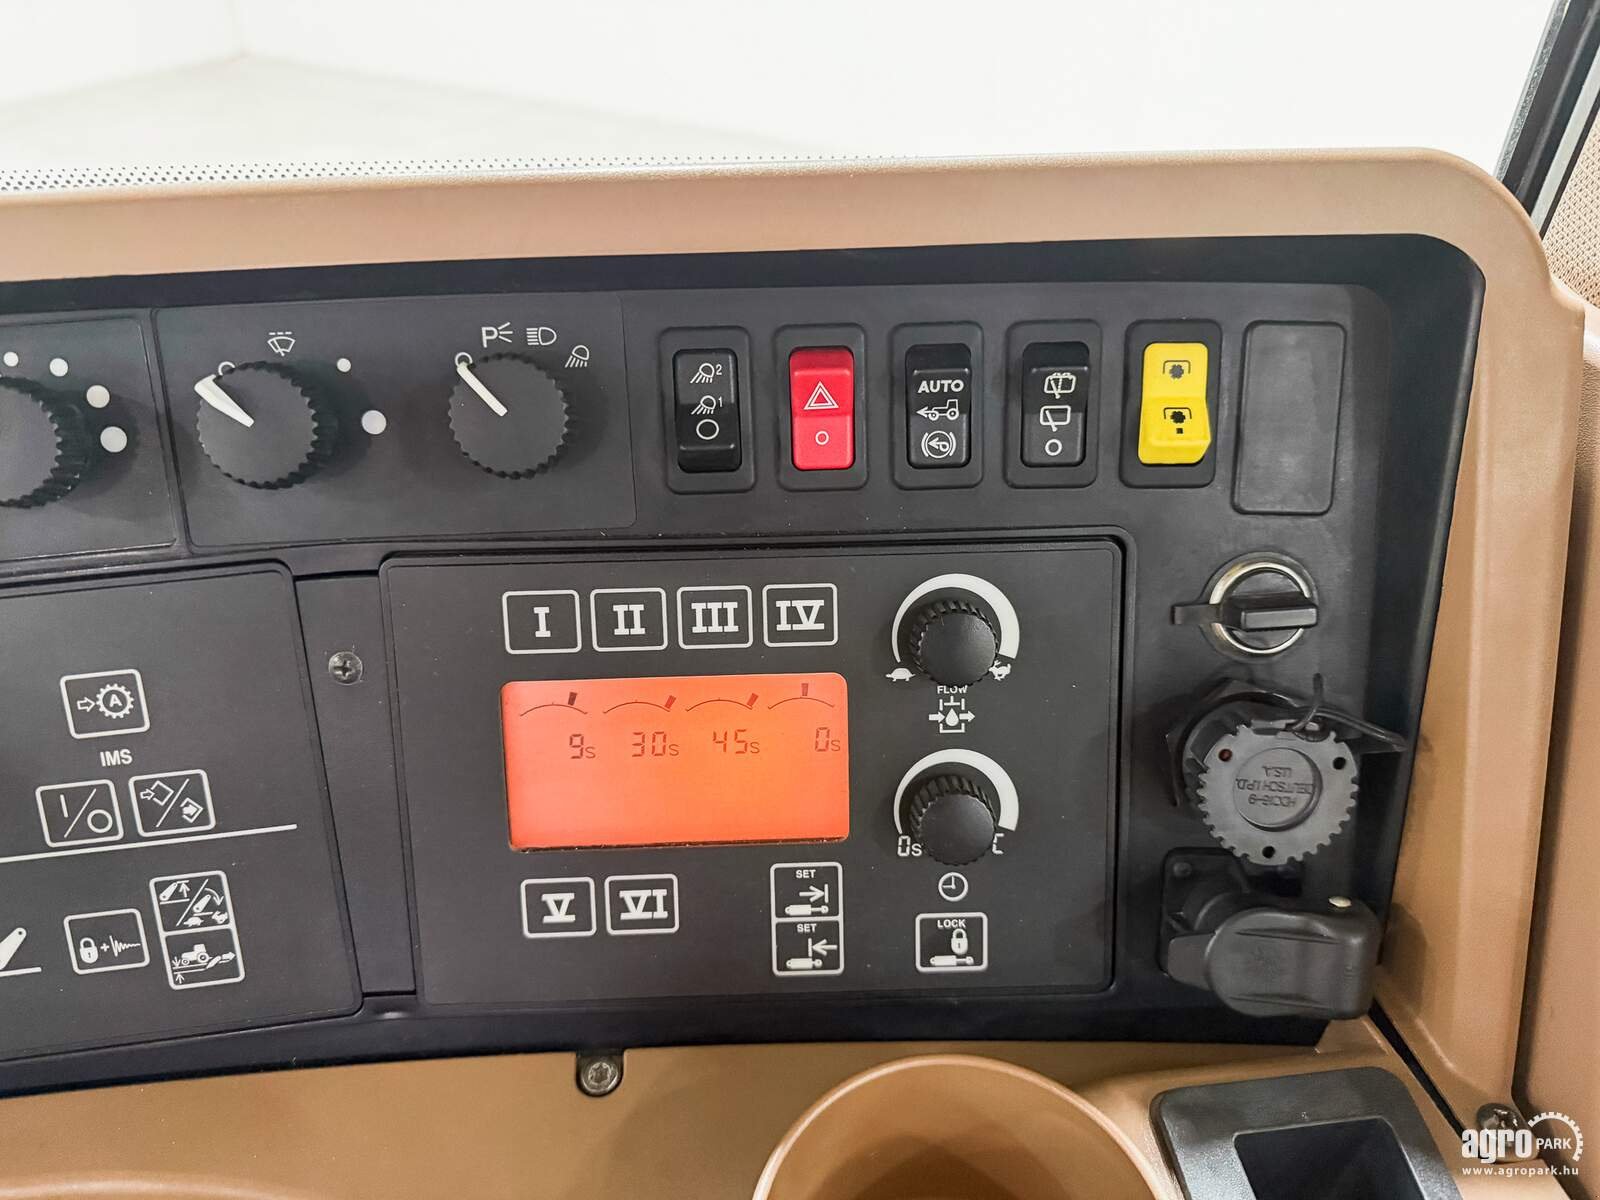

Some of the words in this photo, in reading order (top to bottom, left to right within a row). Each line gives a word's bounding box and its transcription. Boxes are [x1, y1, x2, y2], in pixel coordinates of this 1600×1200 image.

[918, 379, 965, 394] AUTO
[613, 603, 646, 636] II
[691, 601, 739, 633] III
[775, 599, 825, 631] IV
[936, 684, 969, 695] FLOW
[99, 748, 134, 767] IMS
[796, 868, 816, 880] SET
[542, 892, 576, 923] V
[619, 888, 669, 921] VI
[797, 923, 817, 934] SET
[937, 918, 967, 930] LOCK
